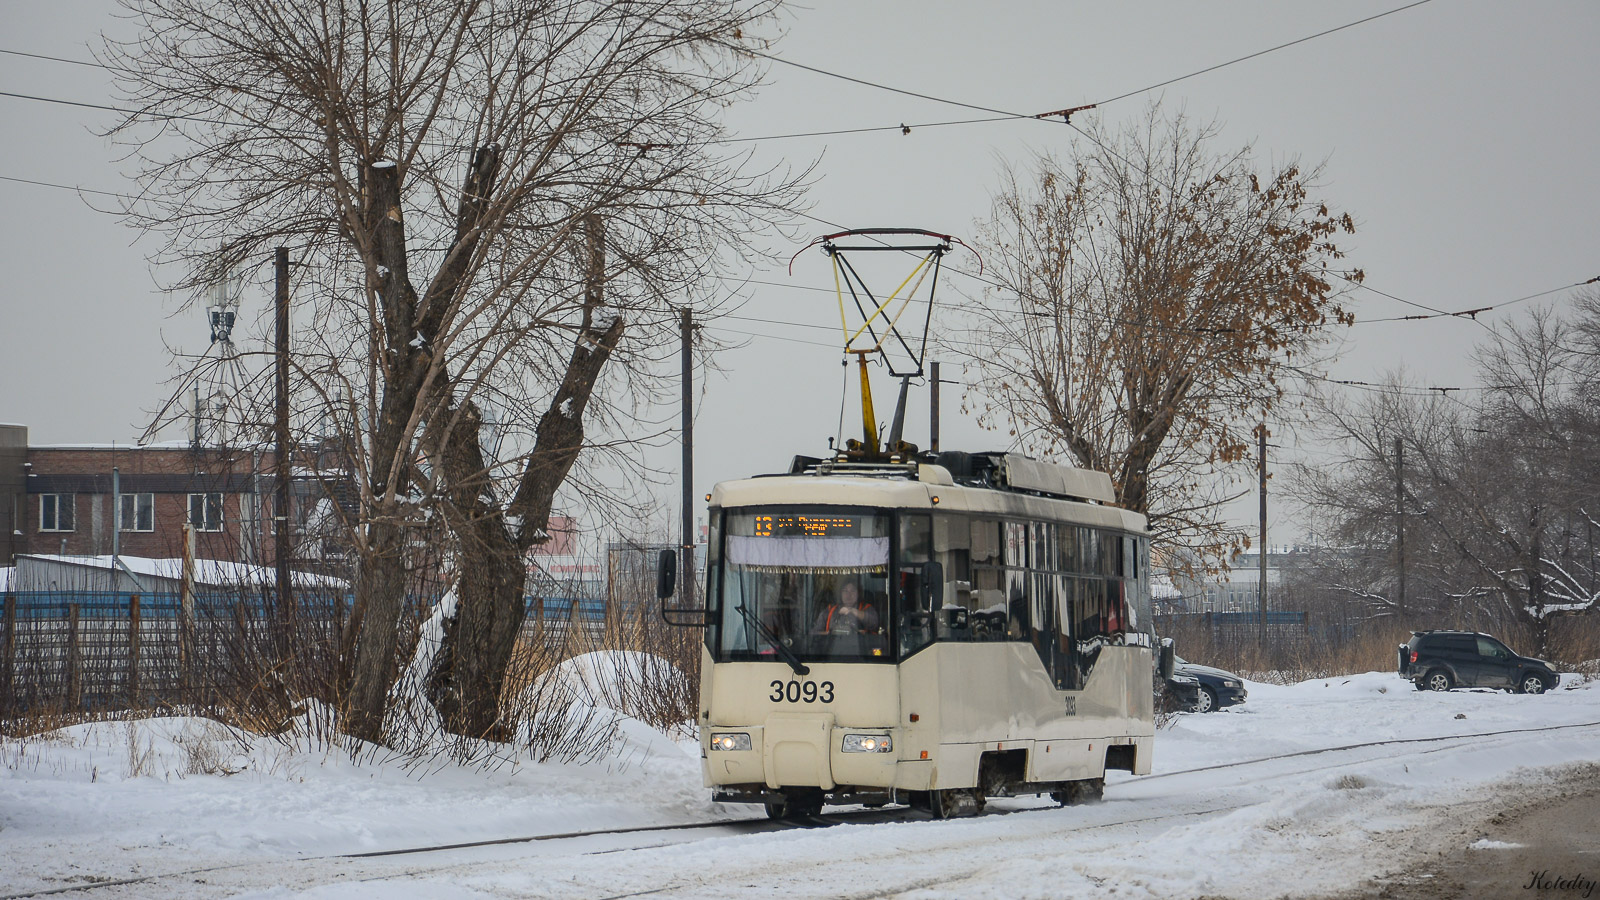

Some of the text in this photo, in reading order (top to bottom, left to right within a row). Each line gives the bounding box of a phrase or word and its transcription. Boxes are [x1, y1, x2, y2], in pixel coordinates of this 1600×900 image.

[756, 516, 772, 536] 13
[769, 680, 834, 703] 3093
[1065, 695, 1076, 716] 3093
